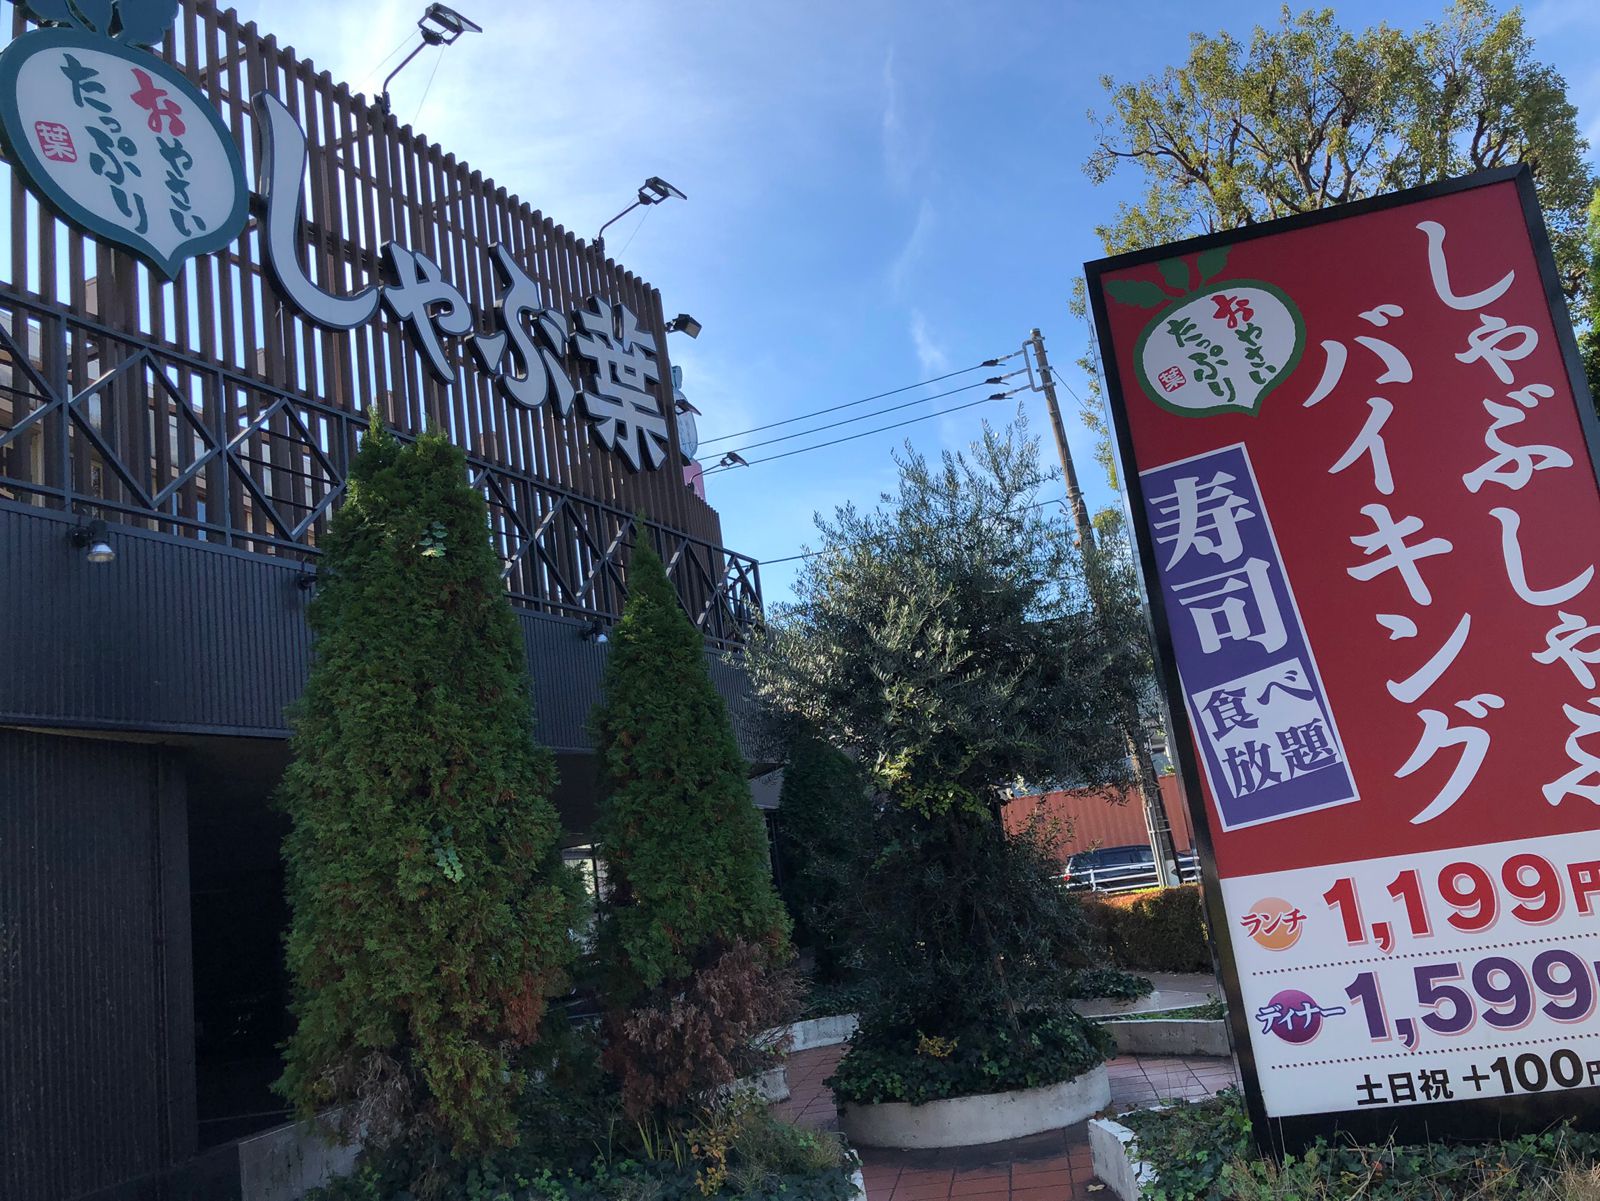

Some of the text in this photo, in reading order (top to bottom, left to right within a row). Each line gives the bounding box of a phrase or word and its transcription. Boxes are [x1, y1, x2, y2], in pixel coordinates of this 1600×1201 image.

[60, 53, 148, 235] たっぷり
[130, 68, 207, 237] おやさい
[254, 89, 668, 473] しゃぶ葉
[1211, 294, 1277, 385] おやさい
[1167, 317, 1237, 403] たっぷり
[1148, 470, 1289, 655] 寿司
[1302, 304, 1505, 825] バイキング
[1240, 908, 1308, 938] ランチ
[1255, 949, 1600, 1052] ディナー 1,599
[1356, 1069, 1454, 1106] 土日祝
